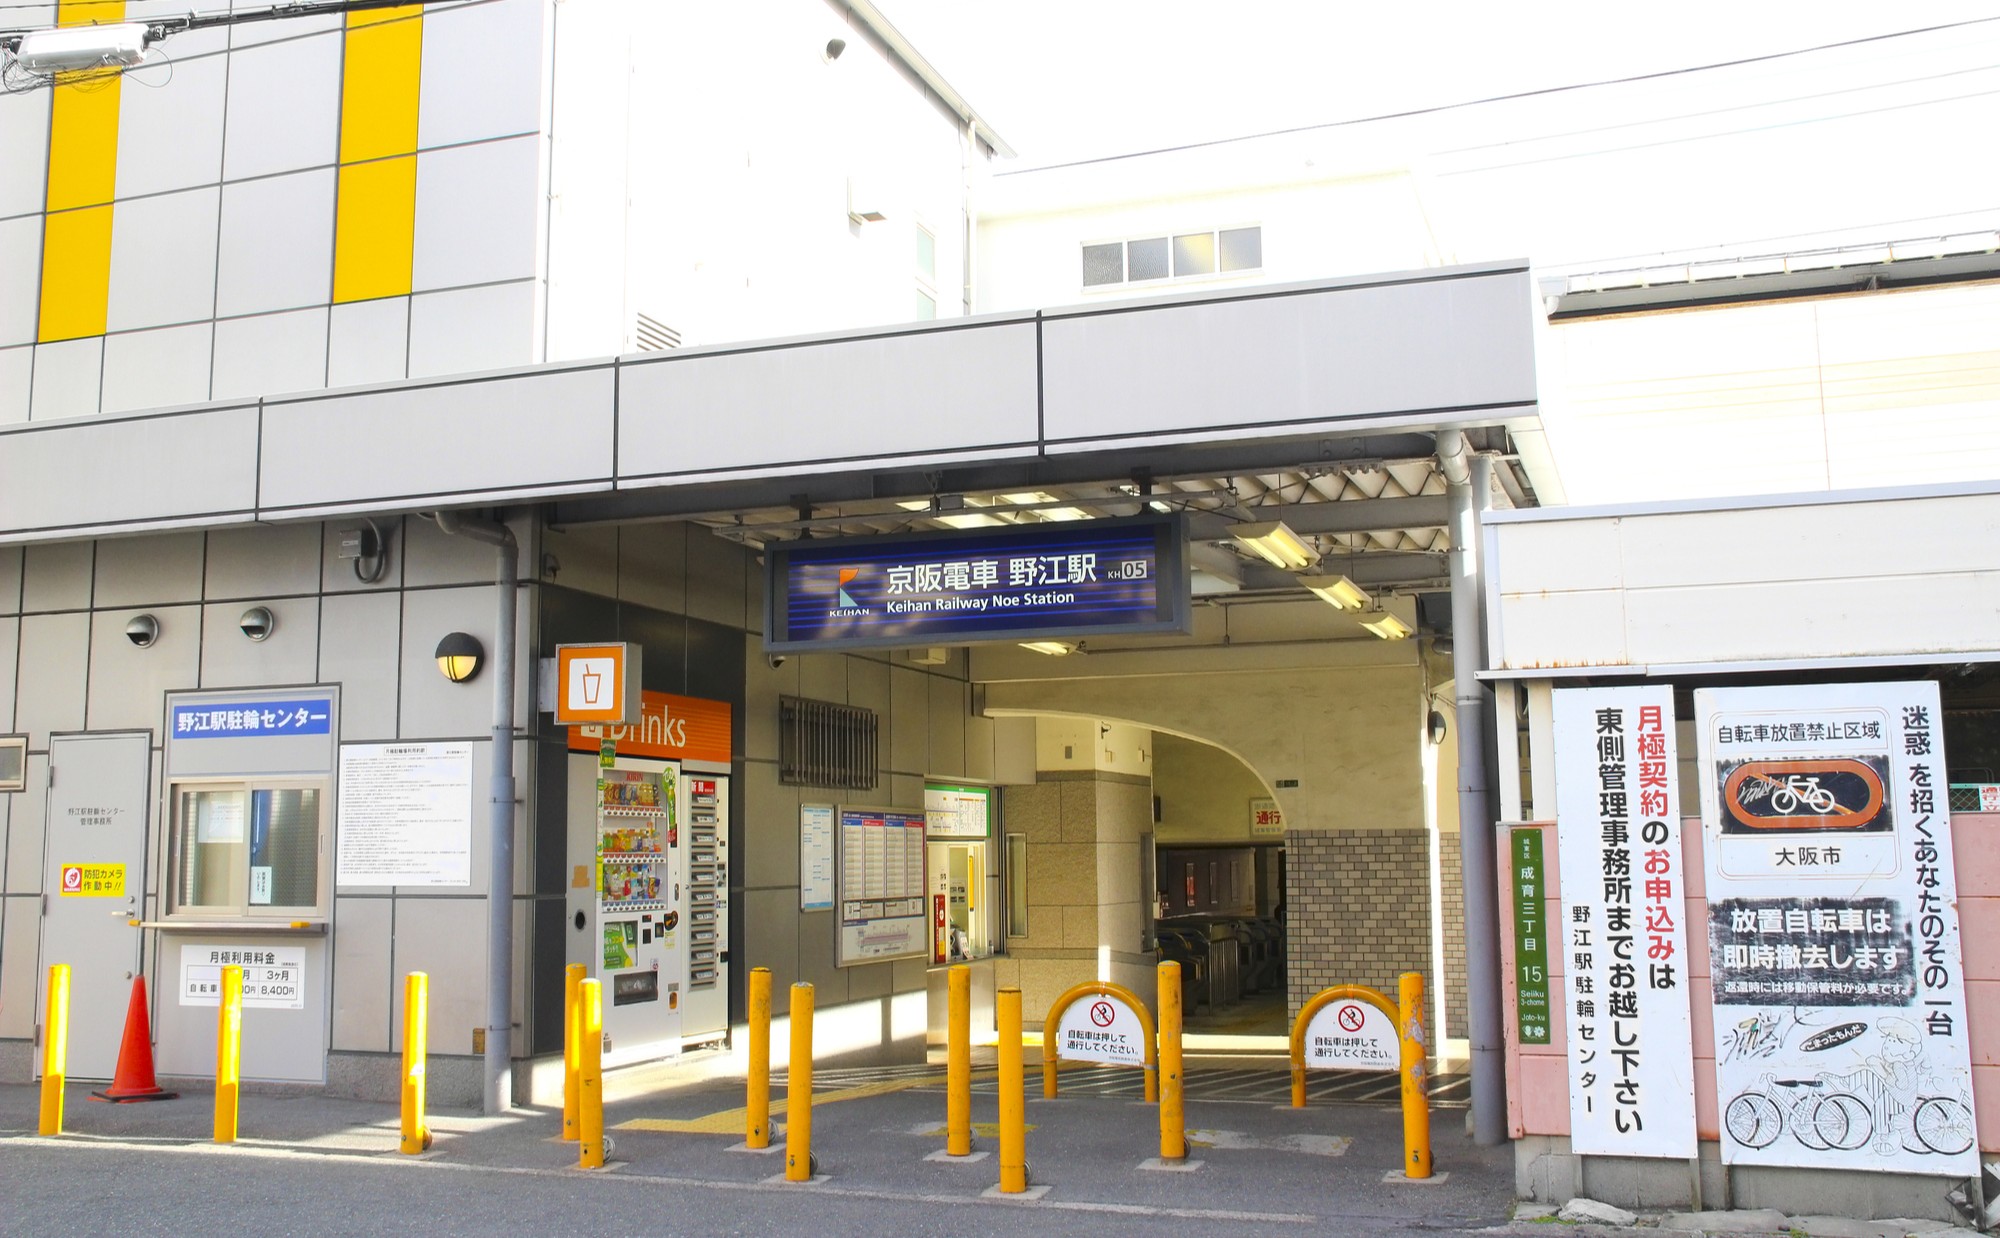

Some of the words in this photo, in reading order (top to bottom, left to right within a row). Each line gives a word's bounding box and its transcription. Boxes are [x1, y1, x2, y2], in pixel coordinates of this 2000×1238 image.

[887, 560, 999, 594] 京阪電車
[1009, 553, 1097, 587] 野江駅
[1108, 570, 1121, 579] KH
[1123, 561, 1146, 578] 05
[829, 608, 870, 617] KEIHAN
[887, 599, 931, 613] Keihan
[936, 597, 989, 611] Railway
[992, 595, 1020, 607] Noe
[1024, 591, 1075, 606] Station
[178, 708, 327, 732] 野江駅駐輪センター
[1718, 721, 1881, 743] 自転車放置禁止区域
[1637, 706, 1675, 989] 月極契約のお申込みは
[1775, 846, 1841, 866] 大阪市
[84, 869, 123, 879] 防犯カメラ
[1521, 866, 1536, 951] 成育三丁目
[1595, 707, 1643, 1133] 東側管理事務所までお越し下さい
[1731, 908, 1892, 934] 放置自転車は
[209, 951, 275, 965] 月極利用料金
[1723, 944, 1905, 970] 即時撤去します
[1522, 966, 1542, 982] 15
[190, 984, 218, 993] 自転車
[261, 985, 295, 996] 8,400円
[1572, 906, 1597, 1113] 野江駅駐輪センター
[1067, 1029, 1127, 1043] 自転車は押して
[1314, 1036, 1379, 1048] 自転車は押して
